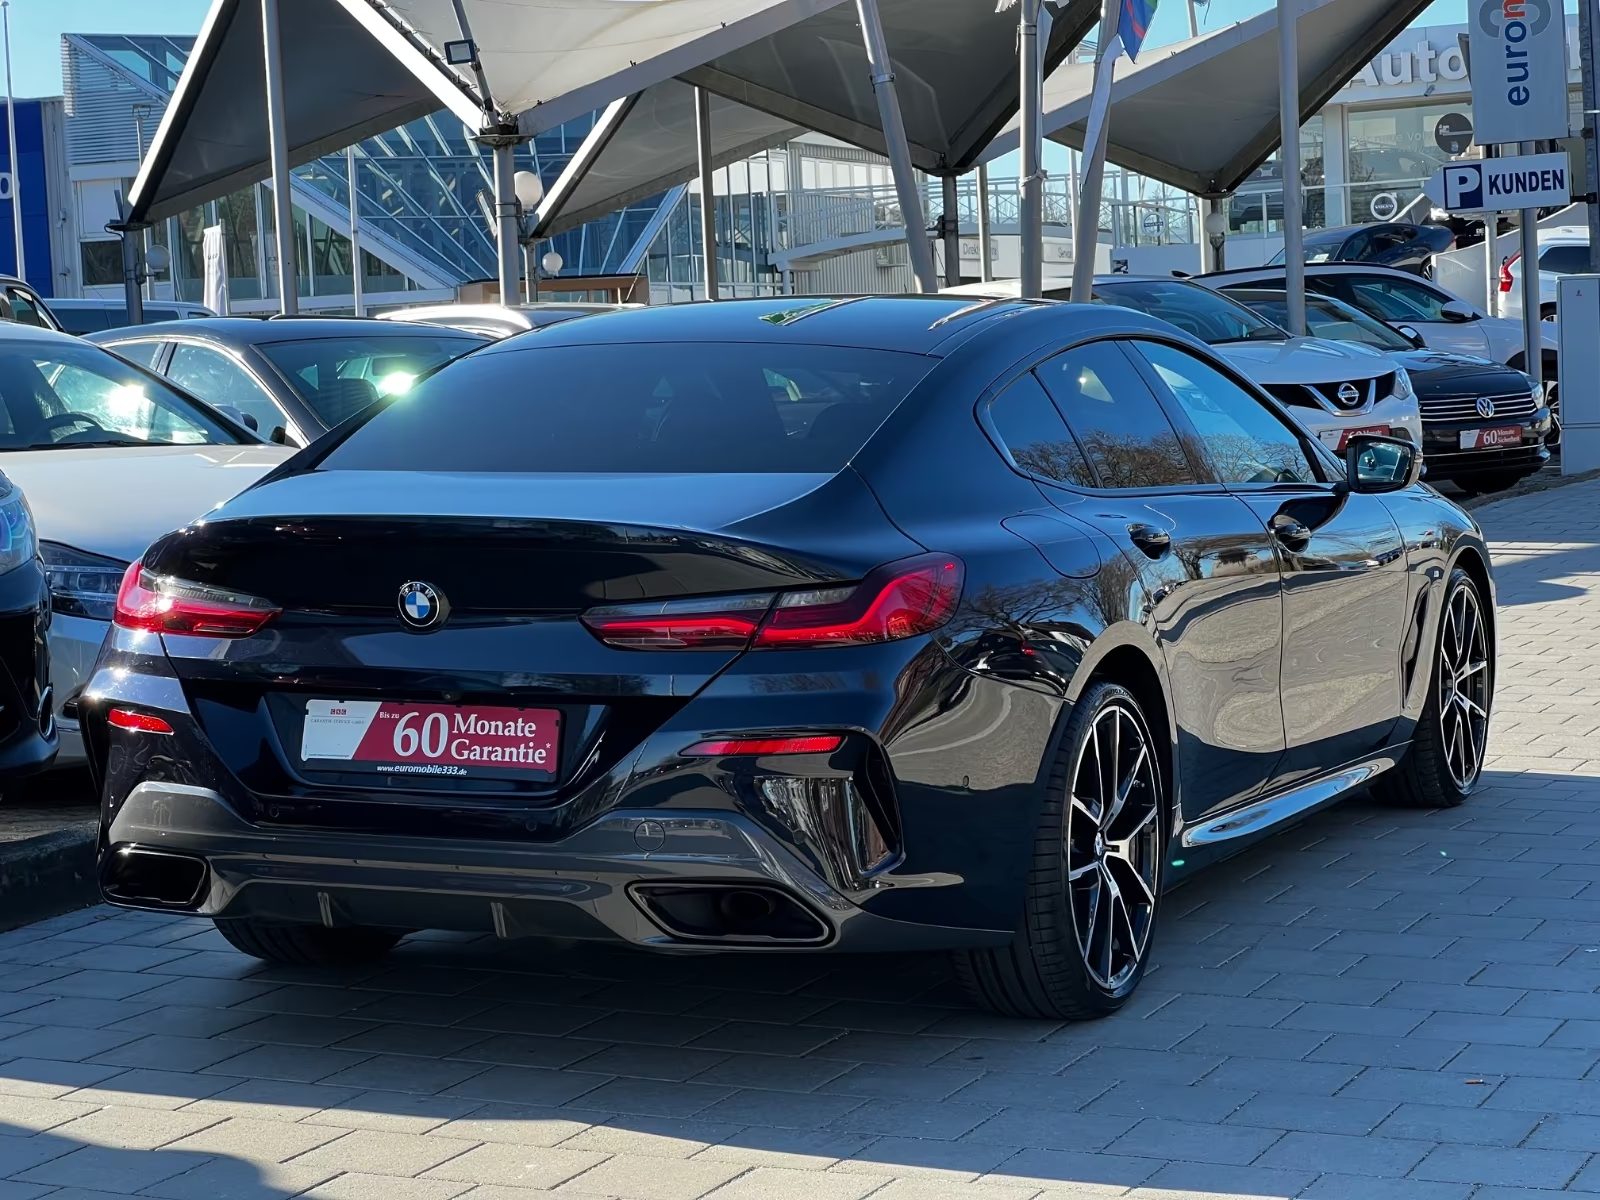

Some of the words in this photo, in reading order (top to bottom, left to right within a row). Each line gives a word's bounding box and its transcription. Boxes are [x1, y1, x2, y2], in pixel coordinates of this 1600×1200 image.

[1446, 167, 1480, 208] P
[1488, 169, 1564, 195] KUNDEN
[1483, 430, 1498, 444] 60
[379, 711, 390, 719] Bis
[393, 711, 449, 758] 60
[452, 713, 537, 737] Monate
[376, 764, 468, 776] www.euromobile333.de
